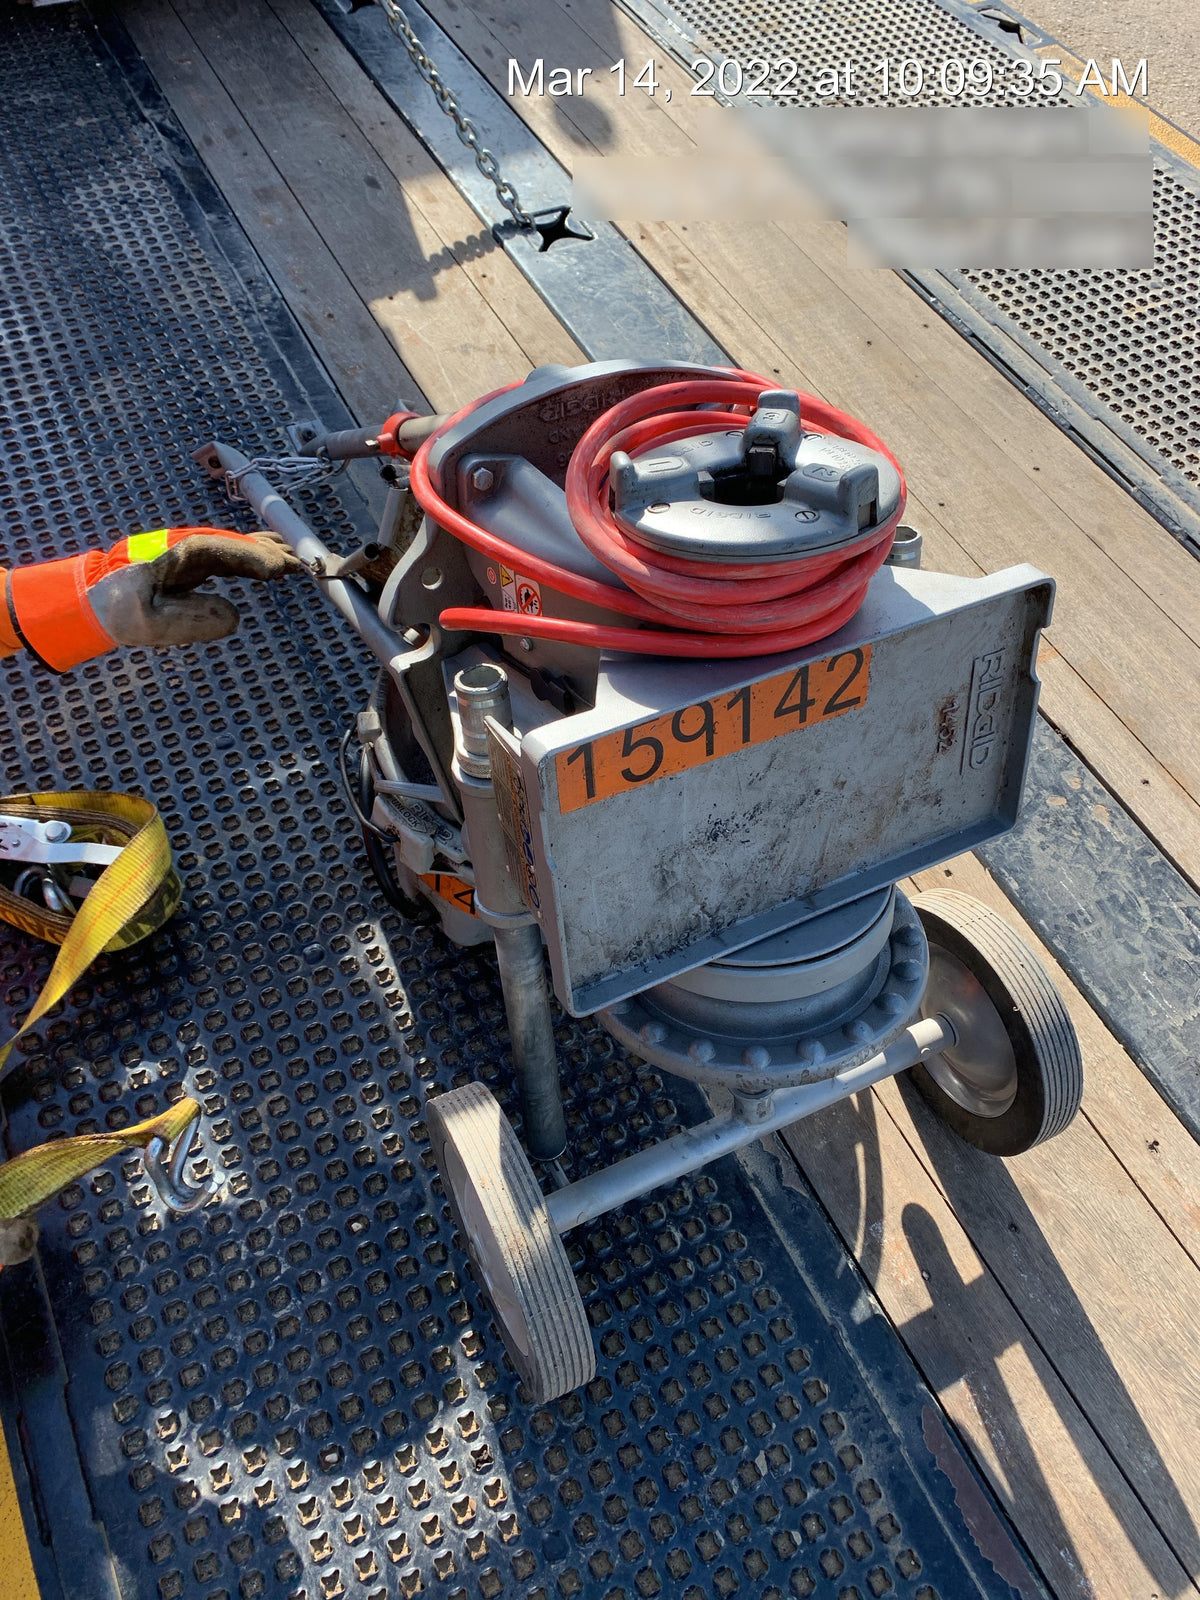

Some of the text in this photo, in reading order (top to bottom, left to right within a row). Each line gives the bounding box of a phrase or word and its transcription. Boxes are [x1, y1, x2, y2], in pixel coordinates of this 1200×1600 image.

[566, 647, 865, 800] 159142
[969, 647, 1006, 770] RIDGID
[391, 797, 421, 828] UNLOCK
